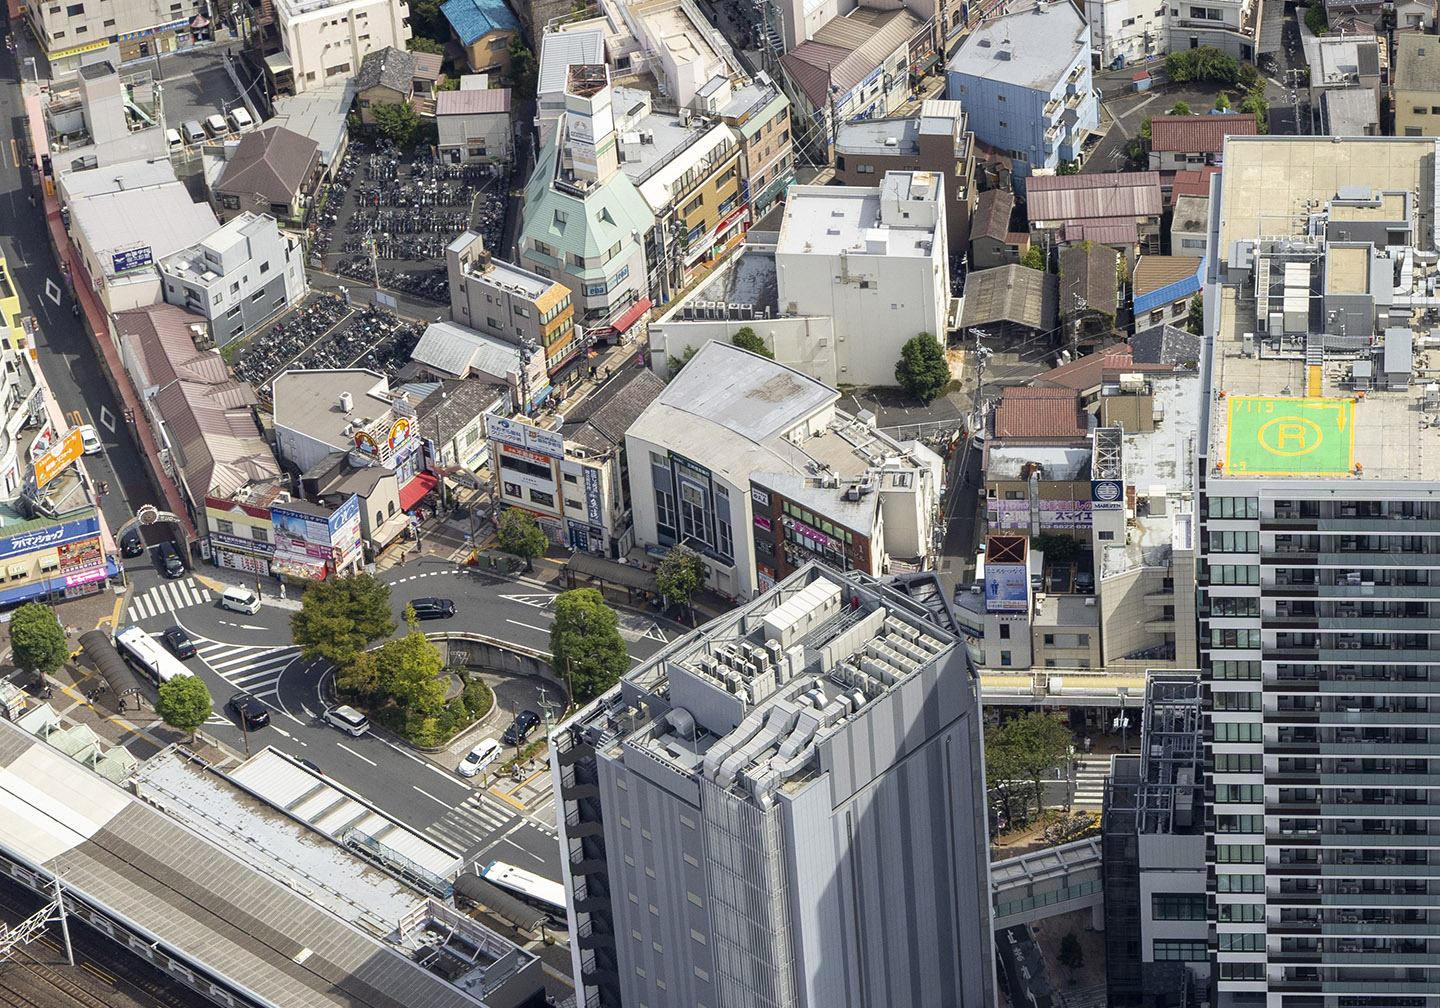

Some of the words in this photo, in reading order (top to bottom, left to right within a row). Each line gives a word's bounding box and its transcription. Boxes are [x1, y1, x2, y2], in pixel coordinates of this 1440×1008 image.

[1278, 423, 1307, 449] R
[12, 529, 64, 549] アパマンショップ
[1007, 929, 1032, 980] 止まれ
